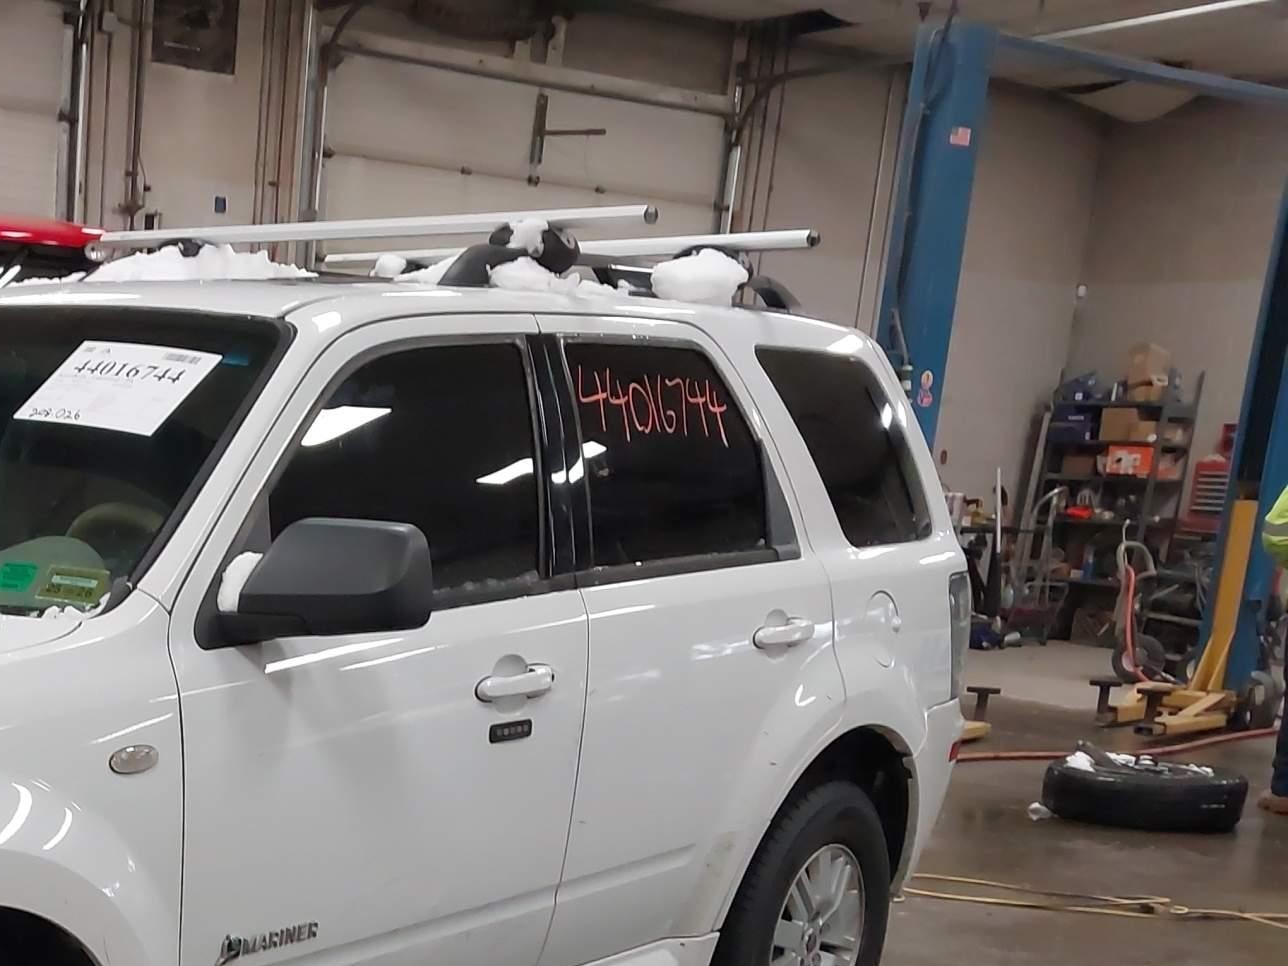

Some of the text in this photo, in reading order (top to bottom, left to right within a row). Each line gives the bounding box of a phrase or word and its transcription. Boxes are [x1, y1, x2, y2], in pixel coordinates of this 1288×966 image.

[74, 359, 186, 384] 44016744
[578, 364, 729, 448] 44016744
[241, 922, 319, 956] MARINER
